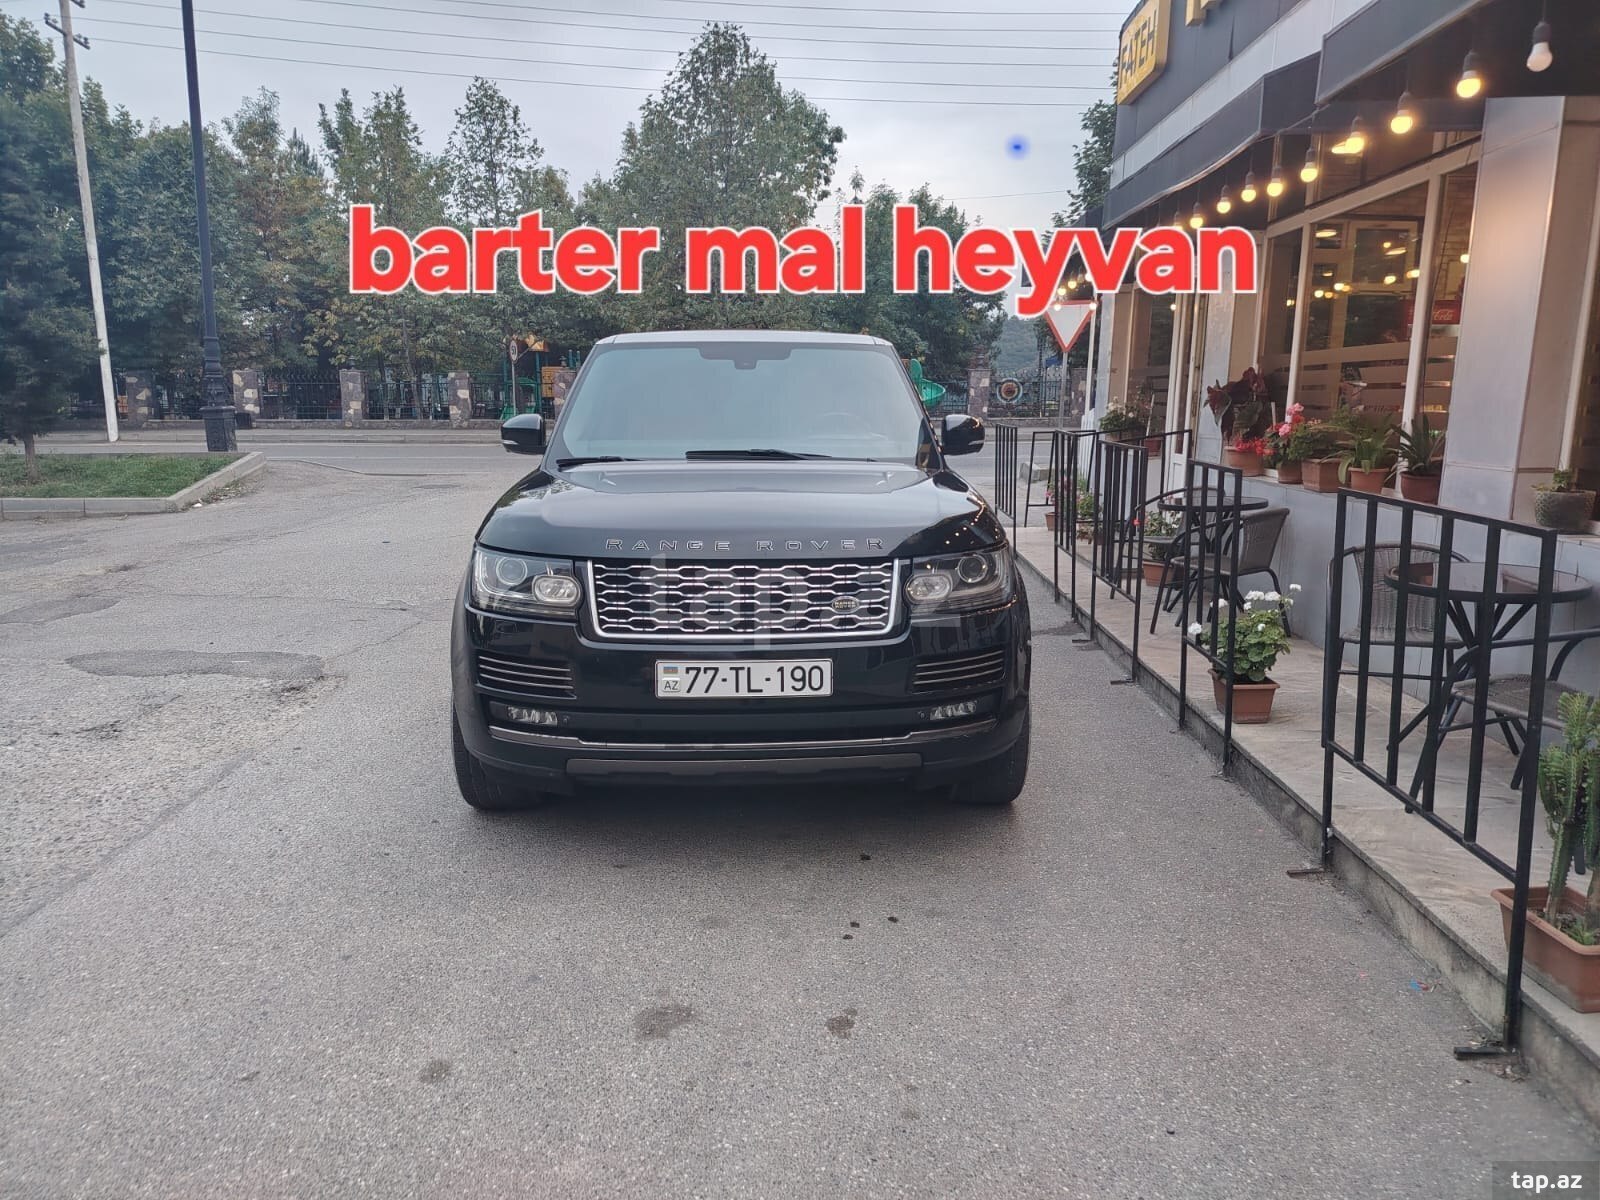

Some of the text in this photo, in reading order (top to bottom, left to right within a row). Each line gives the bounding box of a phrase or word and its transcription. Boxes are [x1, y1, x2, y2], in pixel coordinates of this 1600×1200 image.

[1120, 9, 1157, 89] FATEH
[605, 537, 885, 551] RANGE ROVER
[663, 680, 679, 691] AZ
[685, 665, 824, 694] 77-TL-190
